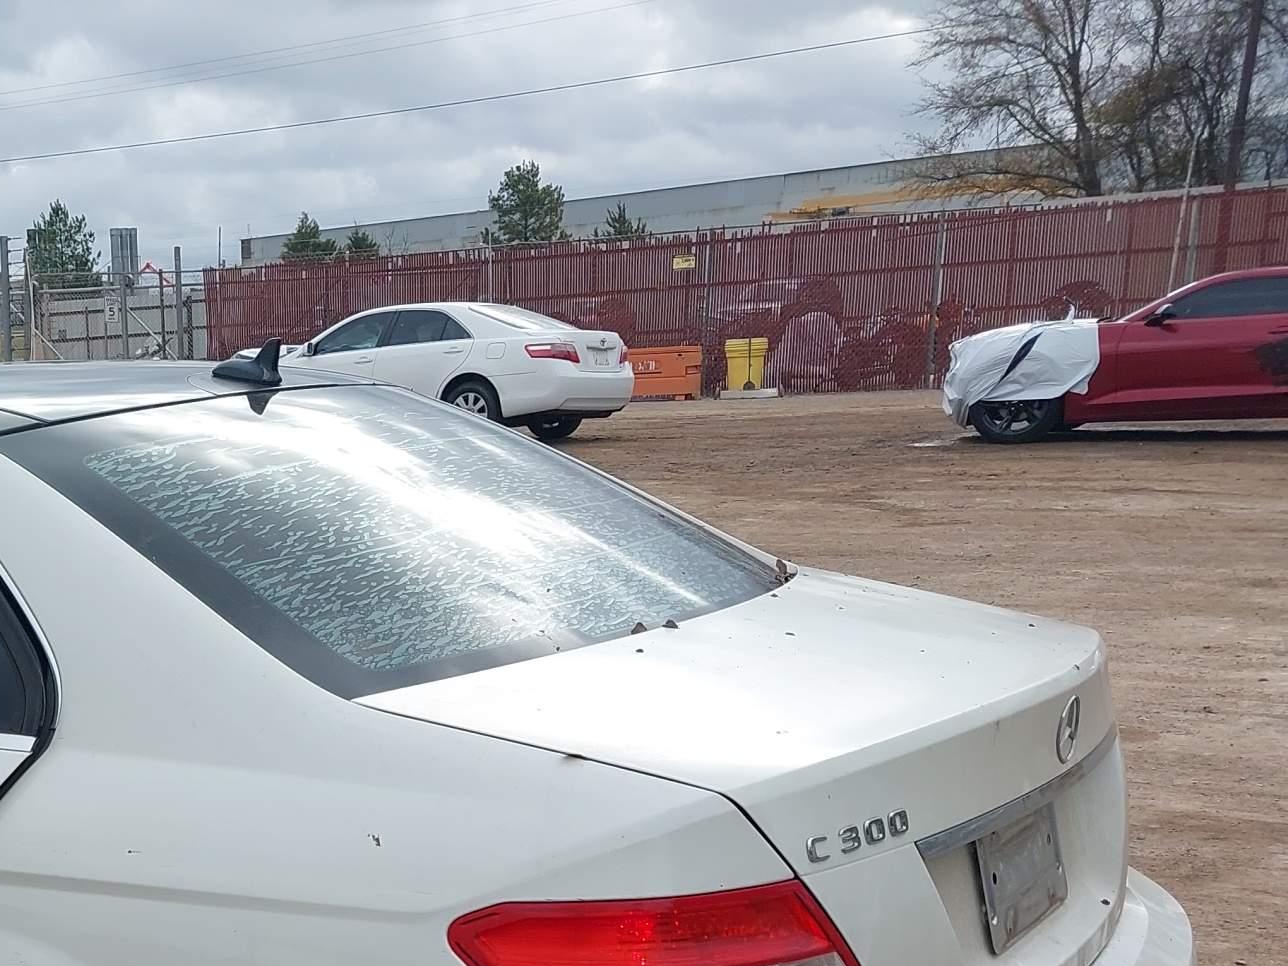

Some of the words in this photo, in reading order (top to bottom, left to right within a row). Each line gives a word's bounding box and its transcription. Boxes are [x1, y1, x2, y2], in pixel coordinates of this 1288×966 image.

[108, 306, 116, 317] 5
[806, 836, 831, 863] C
[838, 808, 909, 854] 300
